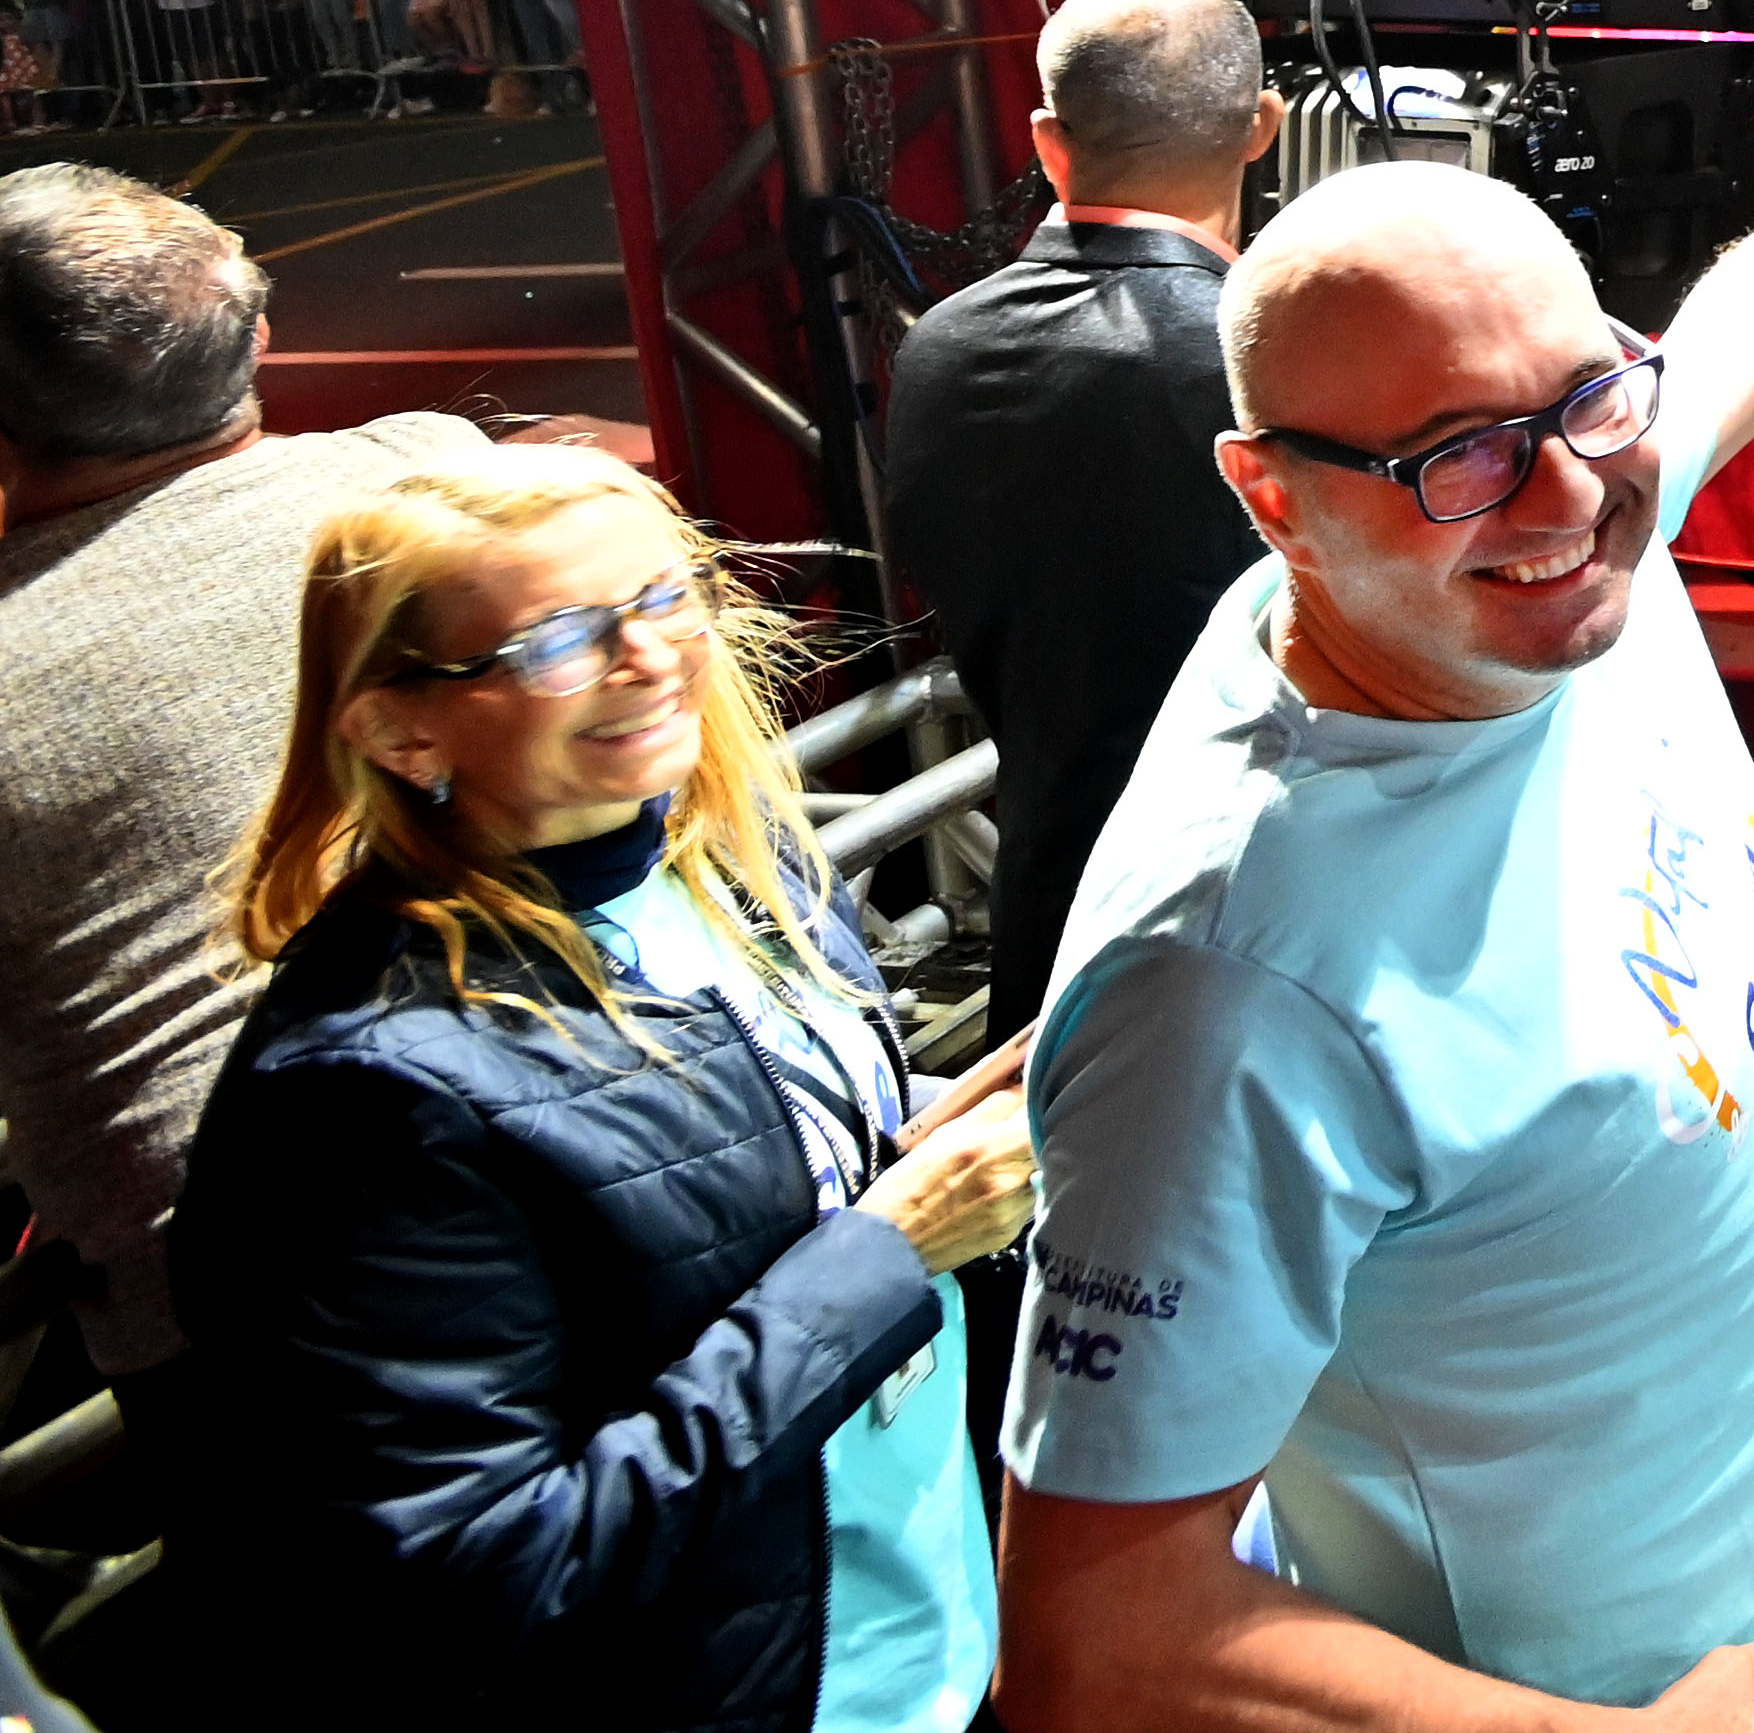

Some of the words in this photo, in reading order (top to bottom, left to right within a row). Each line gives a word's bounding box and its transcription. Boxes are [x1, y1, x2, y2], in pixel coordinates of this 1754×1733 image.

[1554, 157, 1580, 172] aero
[1580, 155, 1595, 170] 20
[1044, 1264, 1182, 1321] CAMPINAS
